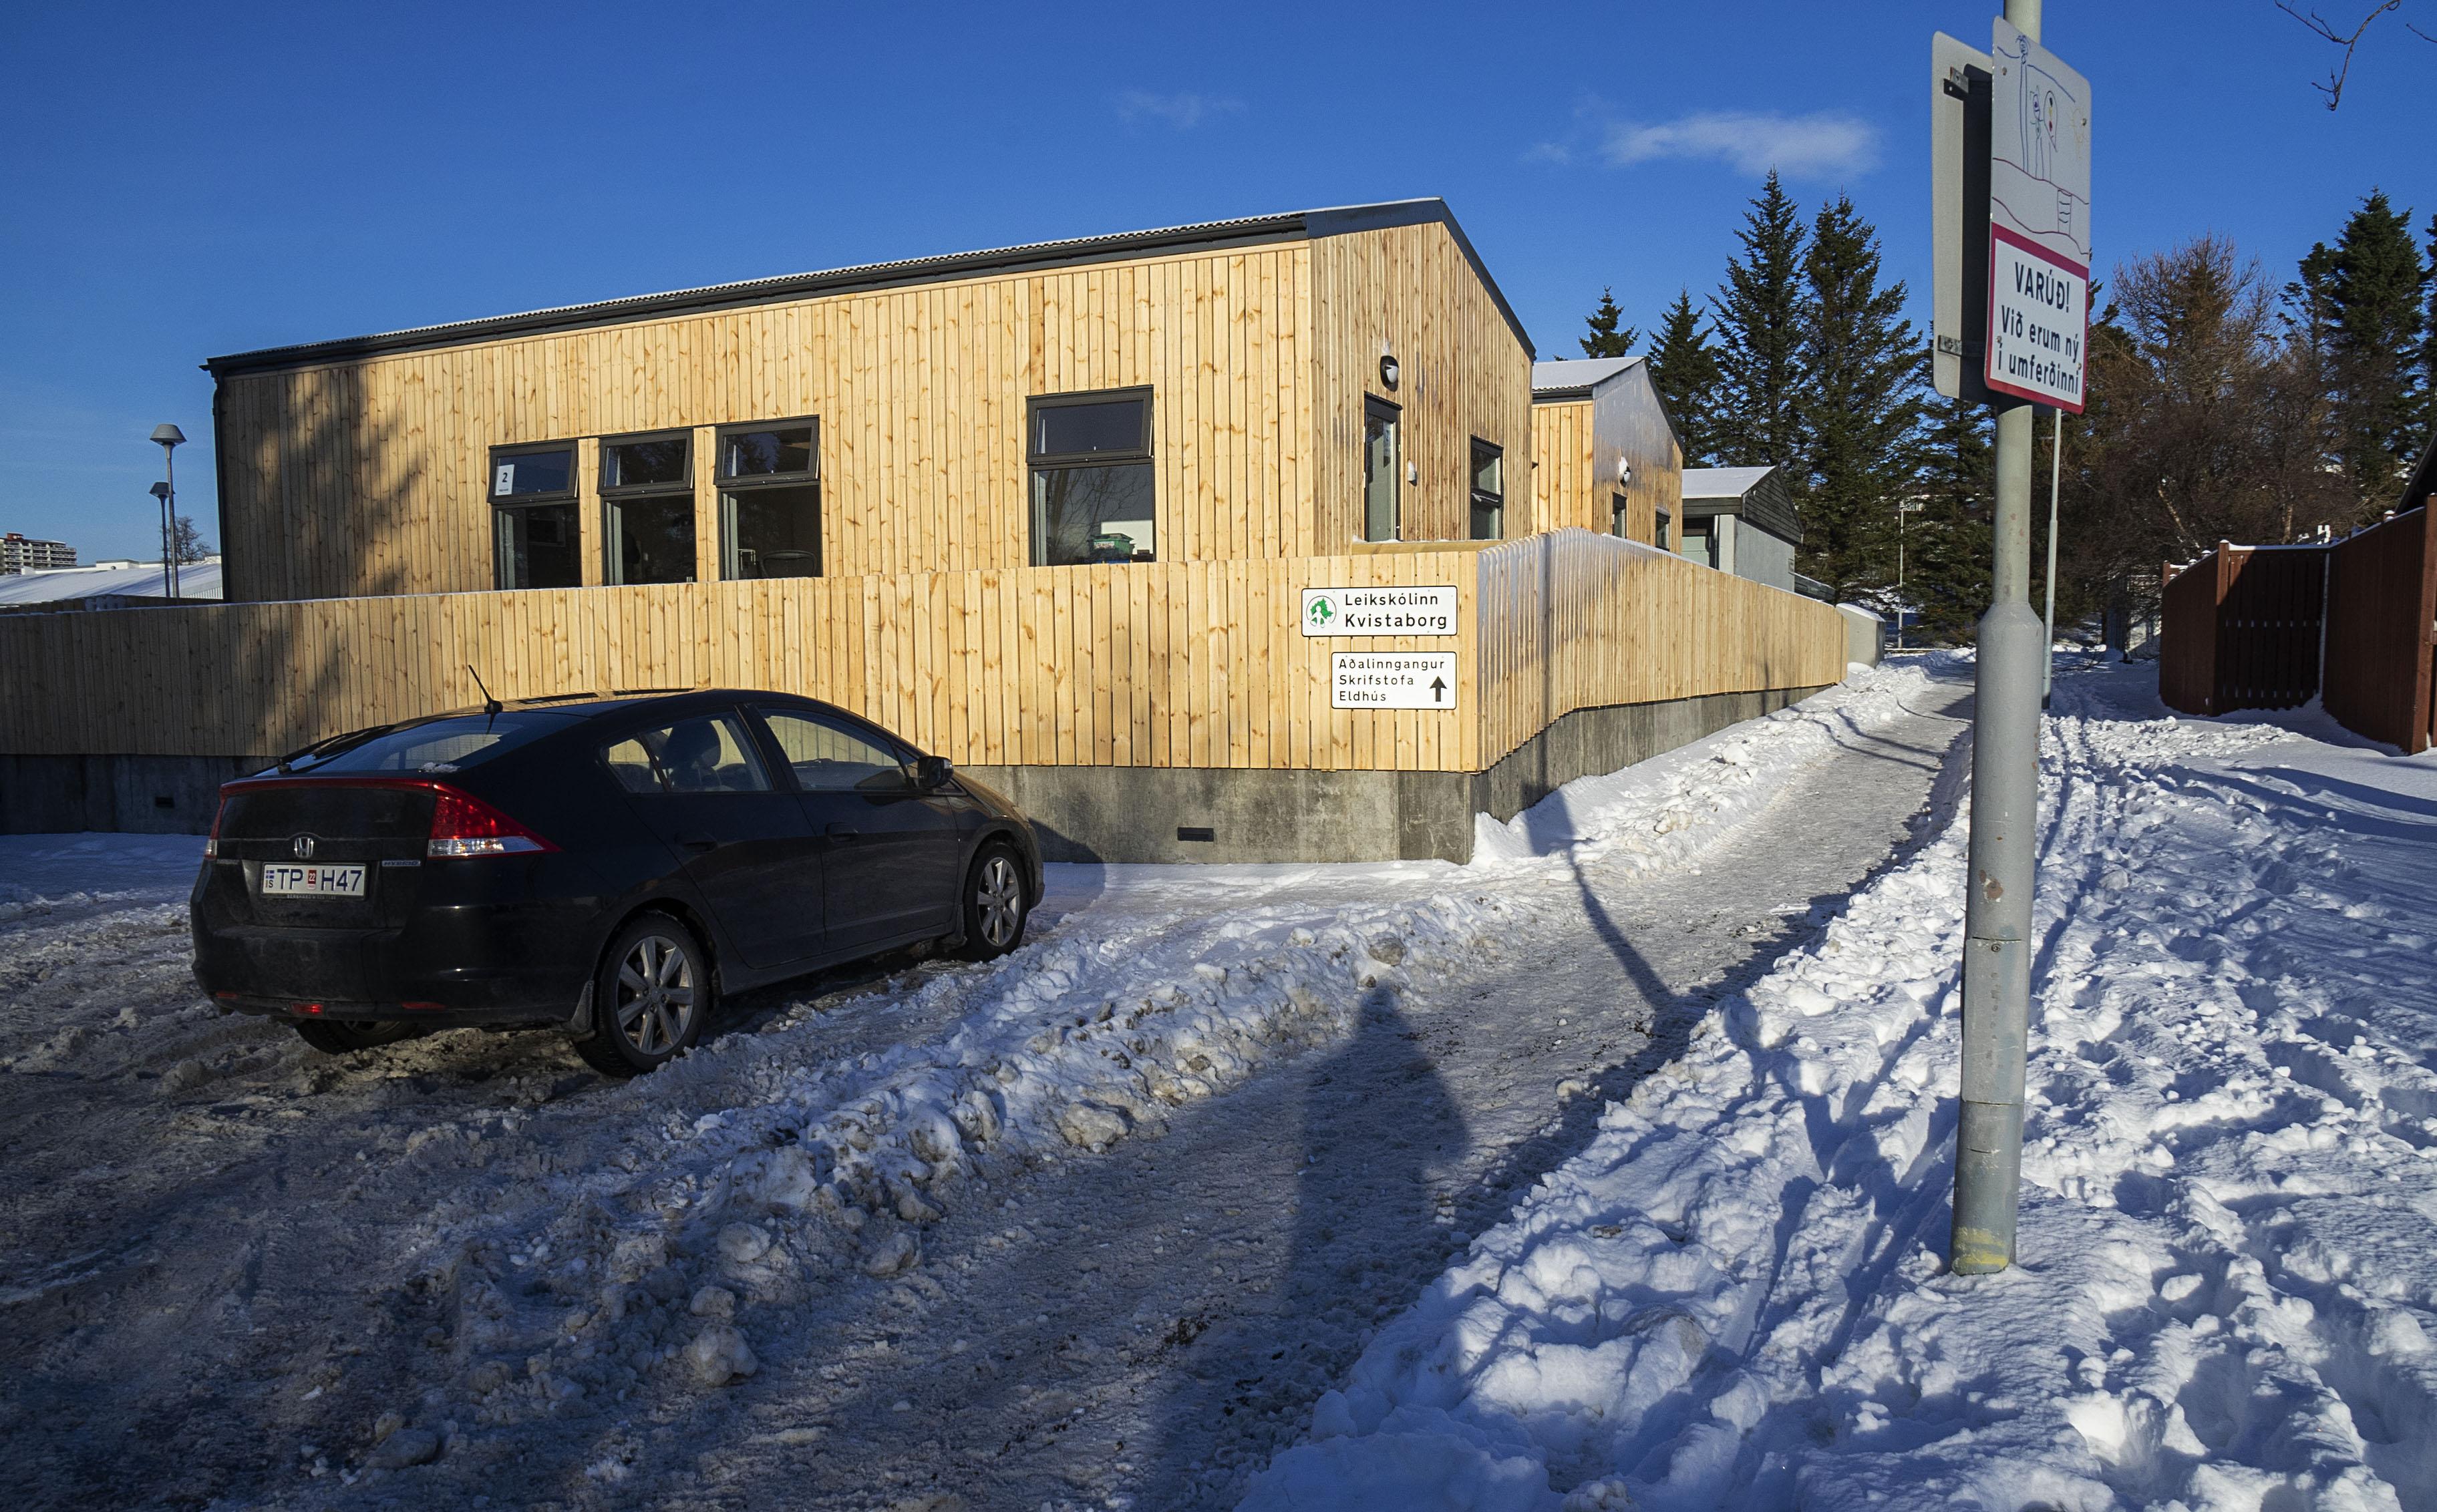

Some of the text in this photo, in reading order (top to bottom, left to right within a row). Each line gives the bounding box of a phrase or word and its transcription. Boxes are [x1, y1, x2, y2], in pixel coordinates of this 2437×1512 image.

[2015, 262, 2070, 313] VARÚÐ!
[2001, 305, 2079, 363] Við erum ný
[2009, 354, 2078, 395] umferðinni
[502, 471, 508, 483] 2
[1345, 593, 1438, 606] Leikskólinn
[1345, 613, 1447, 629] Kvistaborg
[1339, 658, 1444, 671] Aðalinngangur
[1339, 675, 1414, 685] Skrifstofa
[1339, 691, 1386, 701] Eldhús
[277, 869, 303, 890] TP
[309, 873, 315, 882] 22
[321, 870, 363, 892] H47
